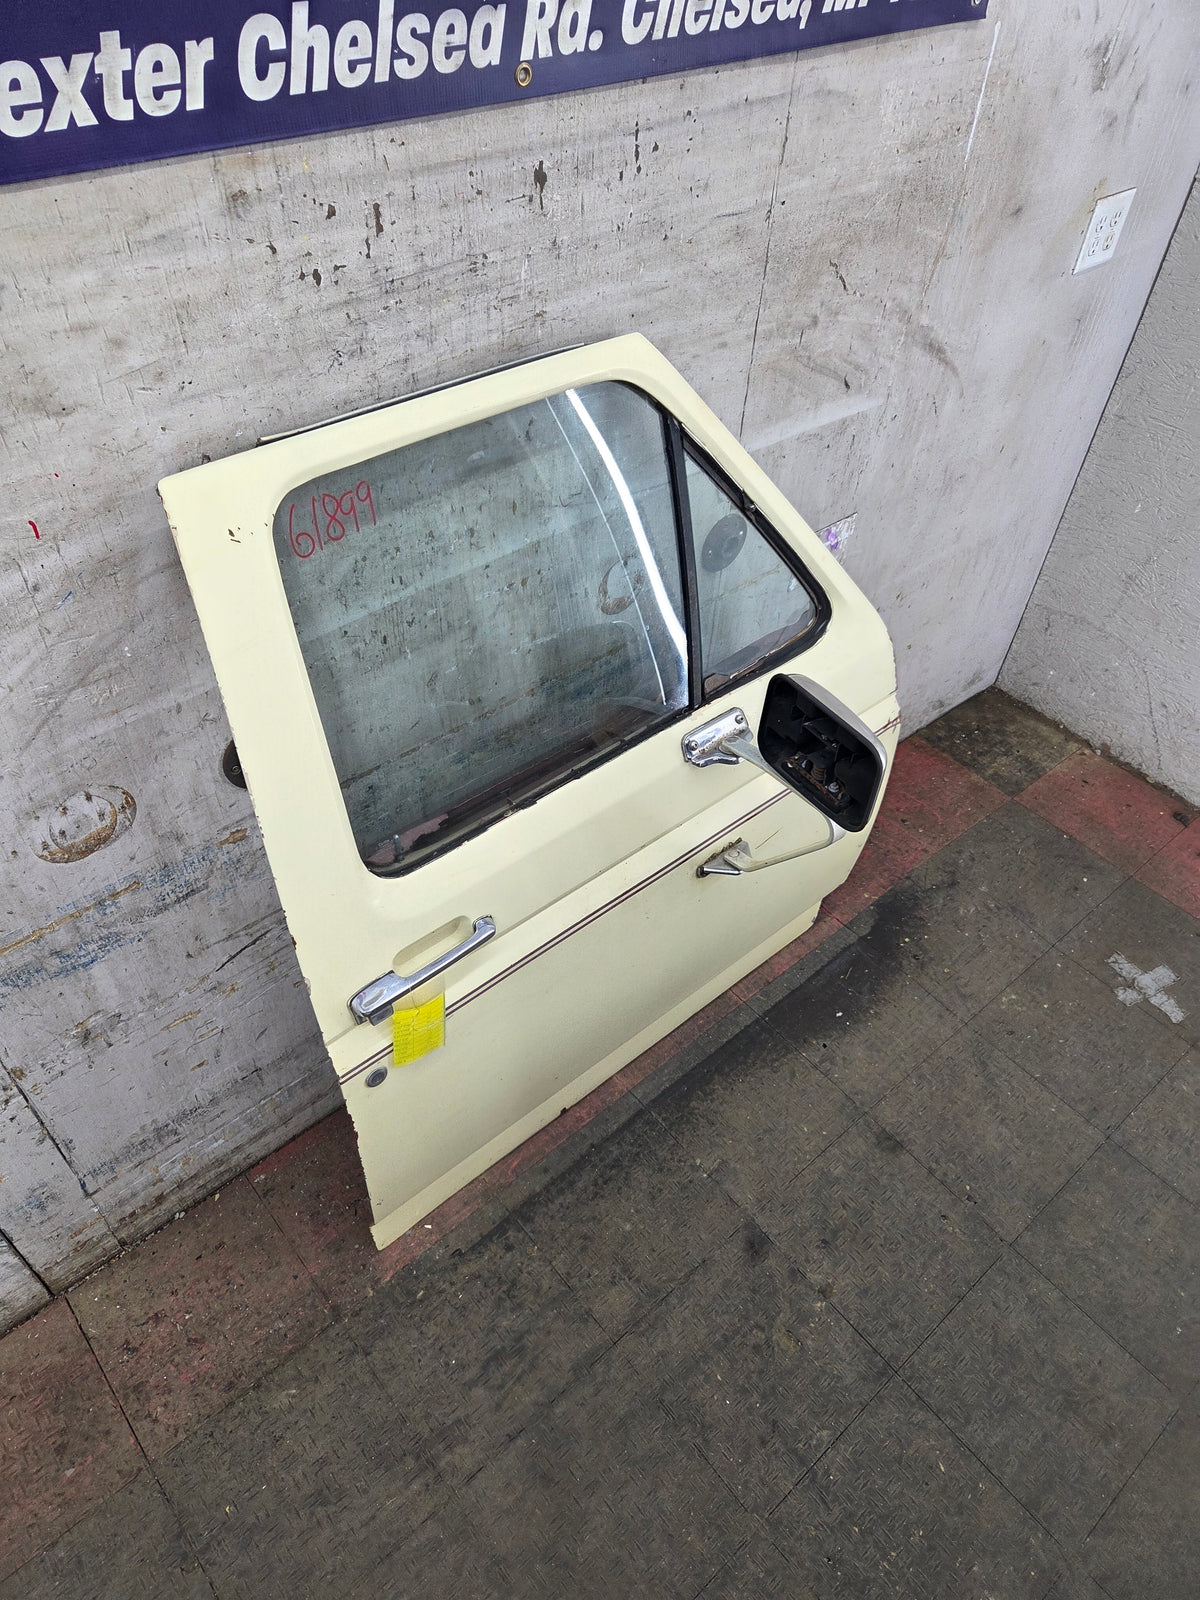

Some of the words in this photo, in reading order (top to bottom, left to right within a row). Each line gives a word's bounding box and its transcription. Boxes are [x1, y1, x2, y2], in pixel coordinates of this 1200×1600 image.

[238, 0, 506, 102] Chelsea
[520, 0, 604, 62] Rd.
[288, 479, 377, 558] 61899
